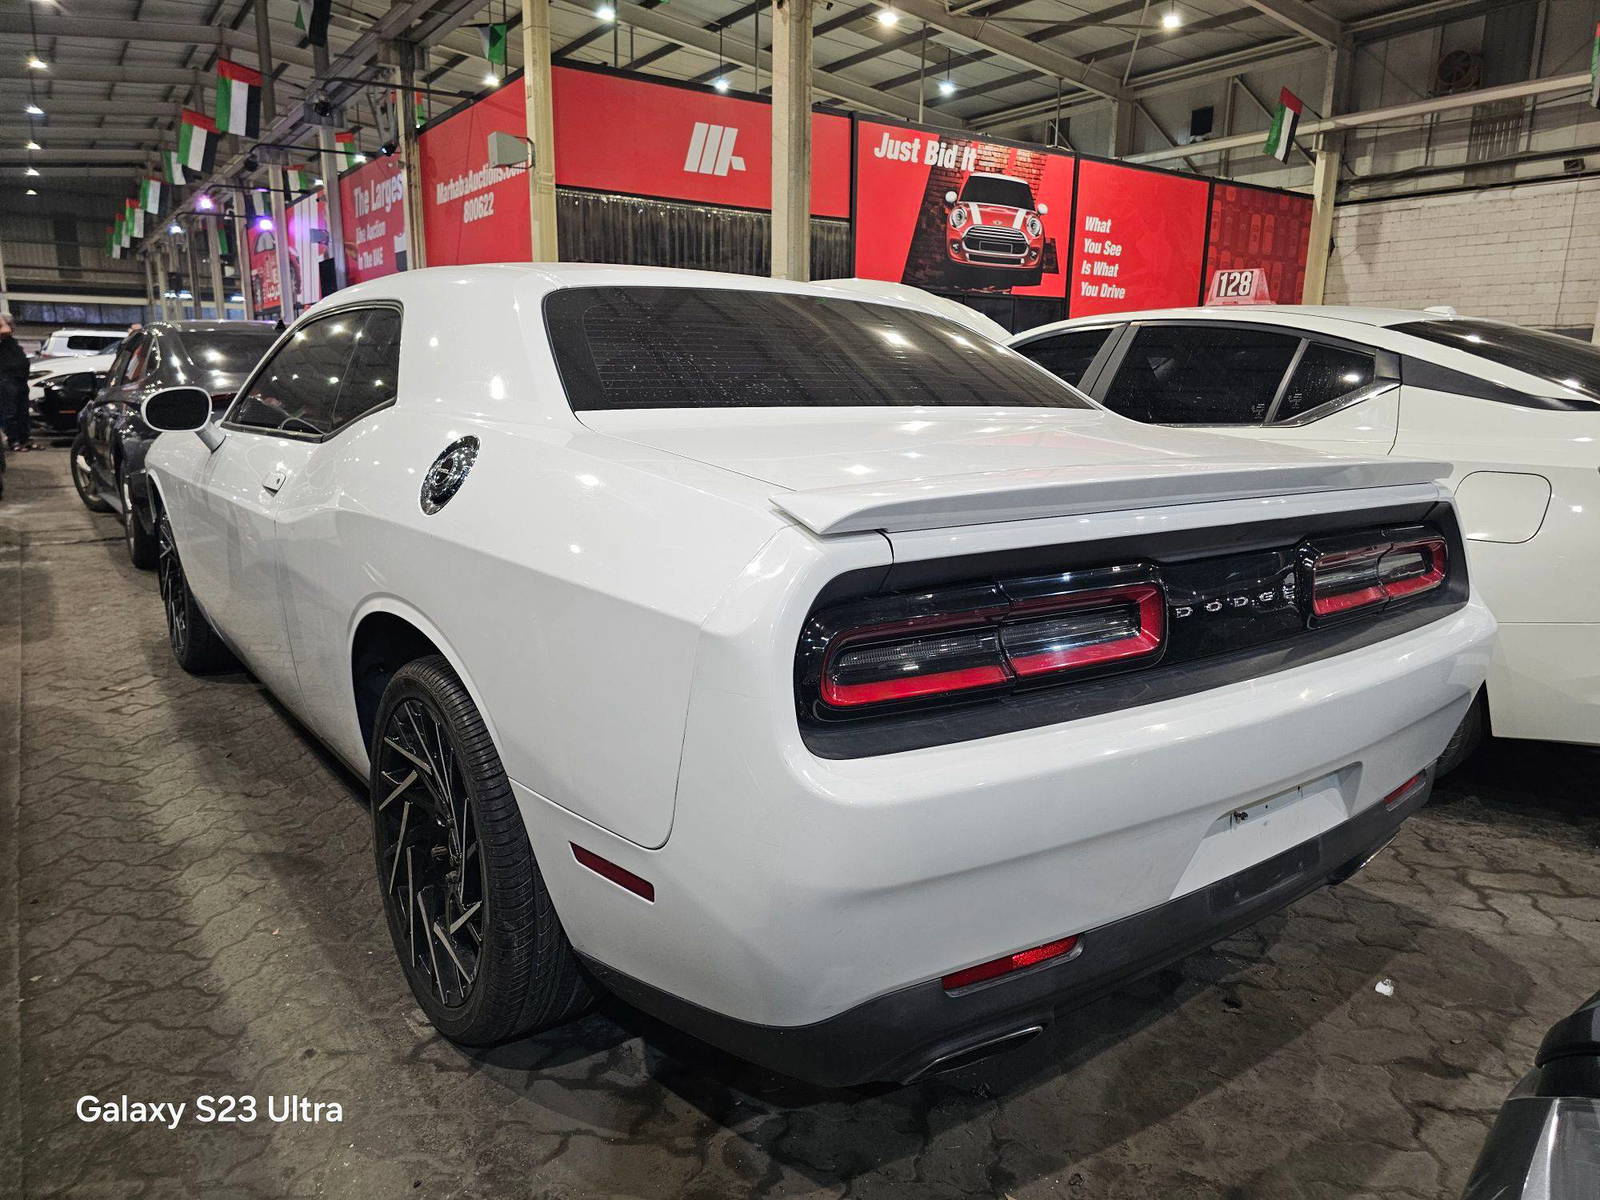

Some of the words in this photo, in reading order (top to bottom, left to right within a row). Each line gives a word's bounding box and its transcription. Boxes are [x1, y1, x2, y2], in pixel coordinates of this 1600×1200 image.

[874, 132, 921, 163] Just
[924, 140, 959, 169] Bid
[961, 146, 977, 172] It
[354, 187, 370, 218] The
[371, 174, 403, 213] Larges
[463, 192, 495, 223] 800622
[1085, 216, 1111, 233] What
[1084, 238, 1102, 254] You
[1103, 240, 1122, 256] See
[1081, 260, 1091, 275] Is
[1093, 261, 1119, 277] What
[1081, 281, 1099, 297] You
[1100, 283, 1126, 299] Drive
[1219, 271, 1252, 297] 128
[1176, 585, 1295, 618] DODGE
